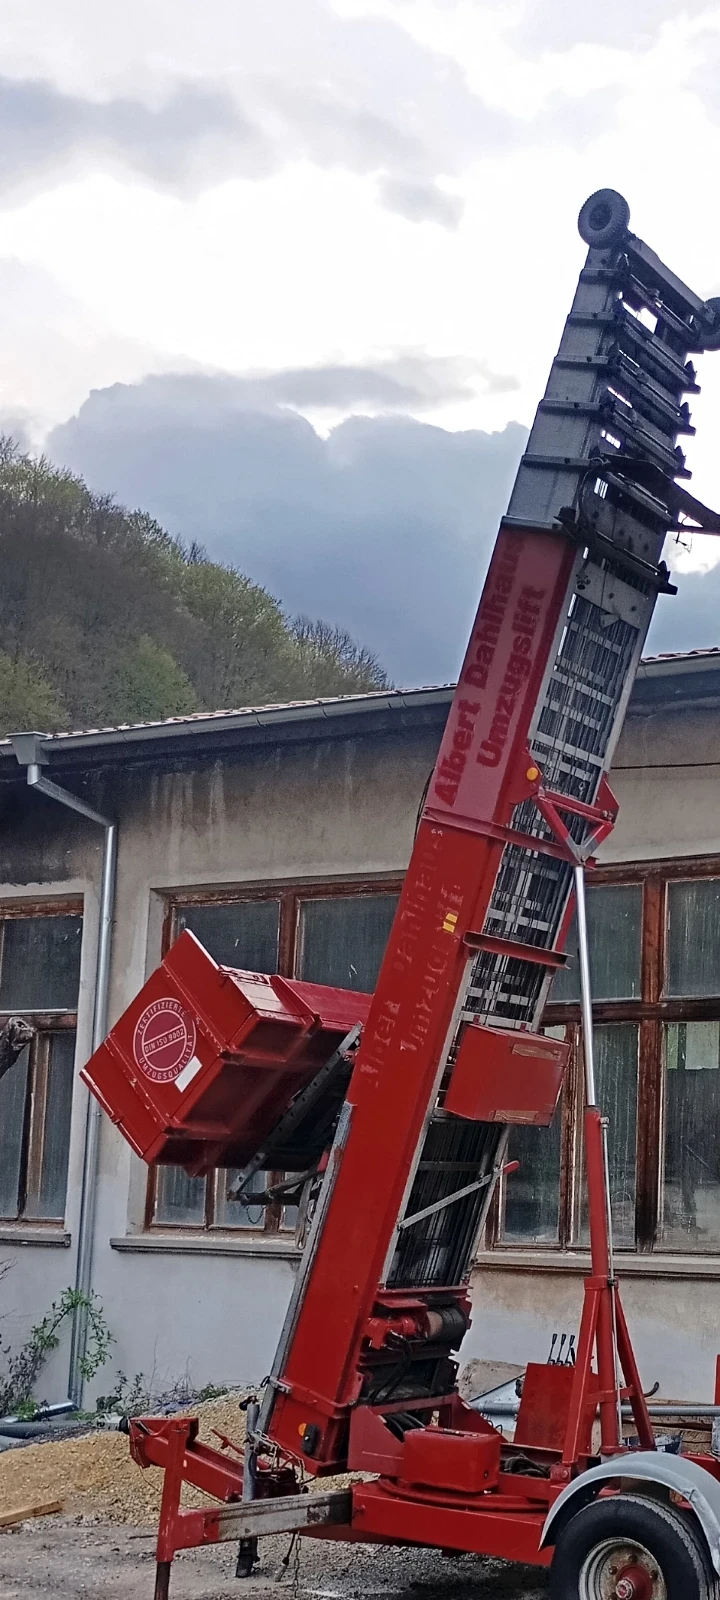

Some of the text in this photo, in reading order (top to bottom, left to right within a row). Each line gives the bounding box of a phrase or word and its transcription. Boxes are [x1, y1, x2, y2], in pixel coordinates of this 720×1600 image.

[435, 533, 525, 808] Albert Dahlhaus
[477, 584, 547, 769] Umzugslift
[138, 1001, 187, 1035] ZERTIFIZIERTE
[144, 1028, 185, 1053] DIN ISO 9002
